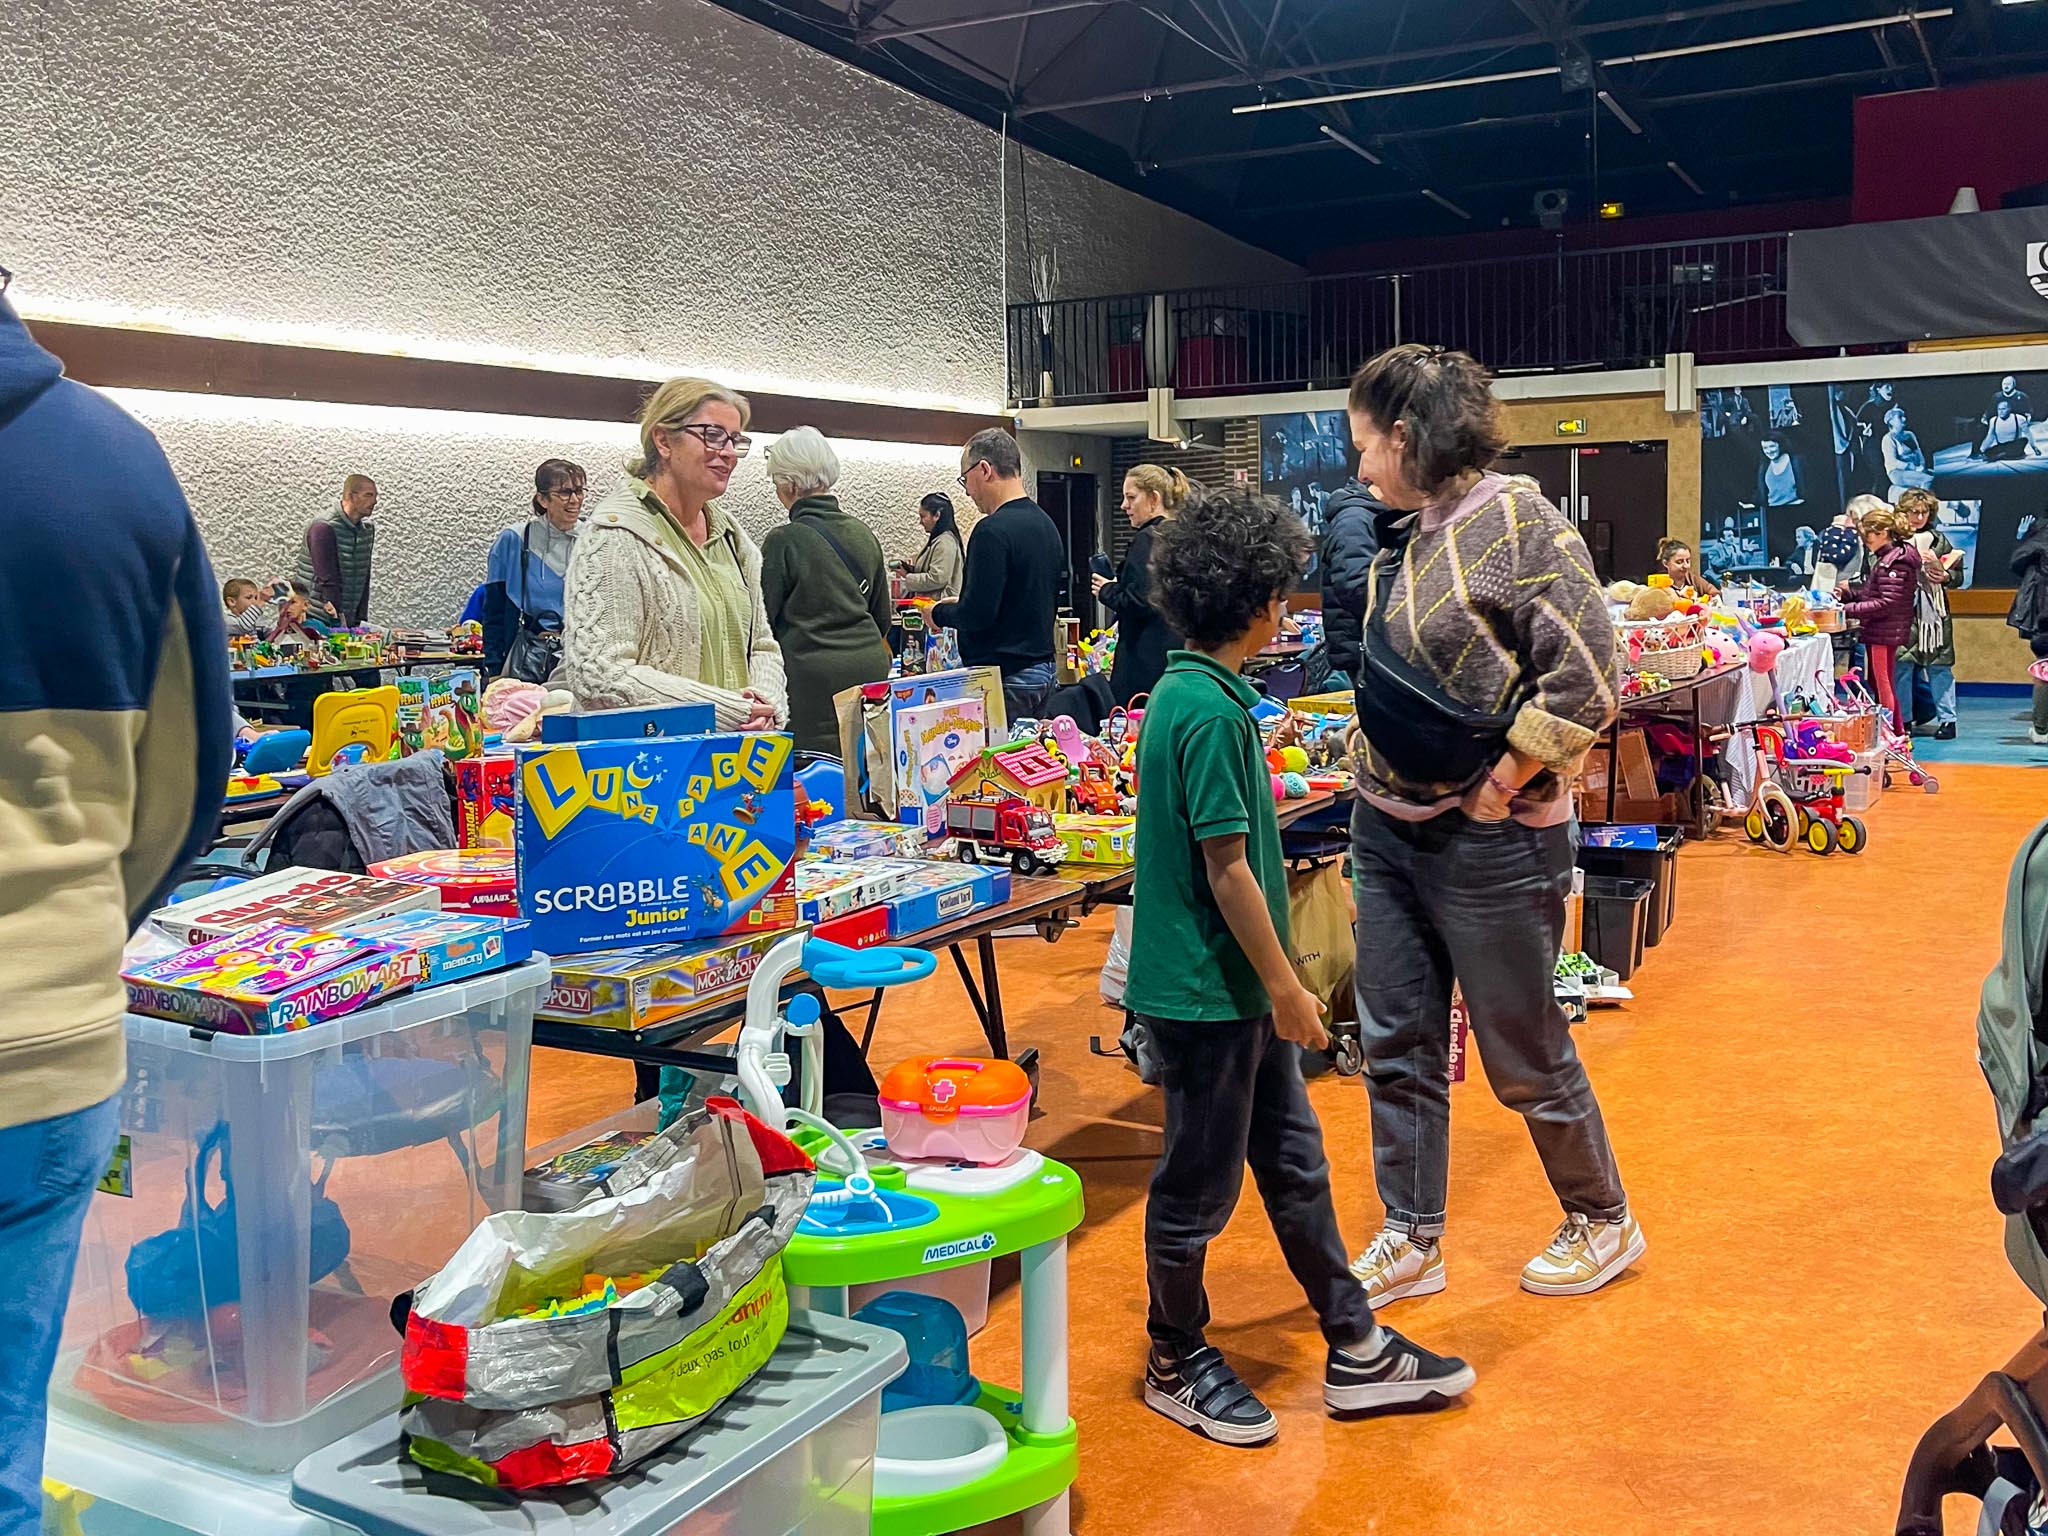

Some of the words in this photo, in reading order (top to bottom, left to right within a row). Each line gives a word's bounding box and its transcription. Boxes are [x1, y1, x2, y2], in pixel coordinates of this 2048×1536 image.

[462, 799, 476, 849] SPIDER-M
[535, 875, 691, 915] SCRABBLE
[784, 877, 795, 891] 2
[193, 875, 352, 924] Cluedo
[625, 906, 690, 928] Junior
[442, 952, 483, 970] memory
[1294, 951, 1321, 966] WITH
[278, 974, 372, 1025] RAINBOW
[374, 956, 413, 985] ART
[1450, 1009, 1463, 1064] Cluedo
[925, 1238, 983, 1261] MEDICAL
[676, 1357, 701, 1377] deux
